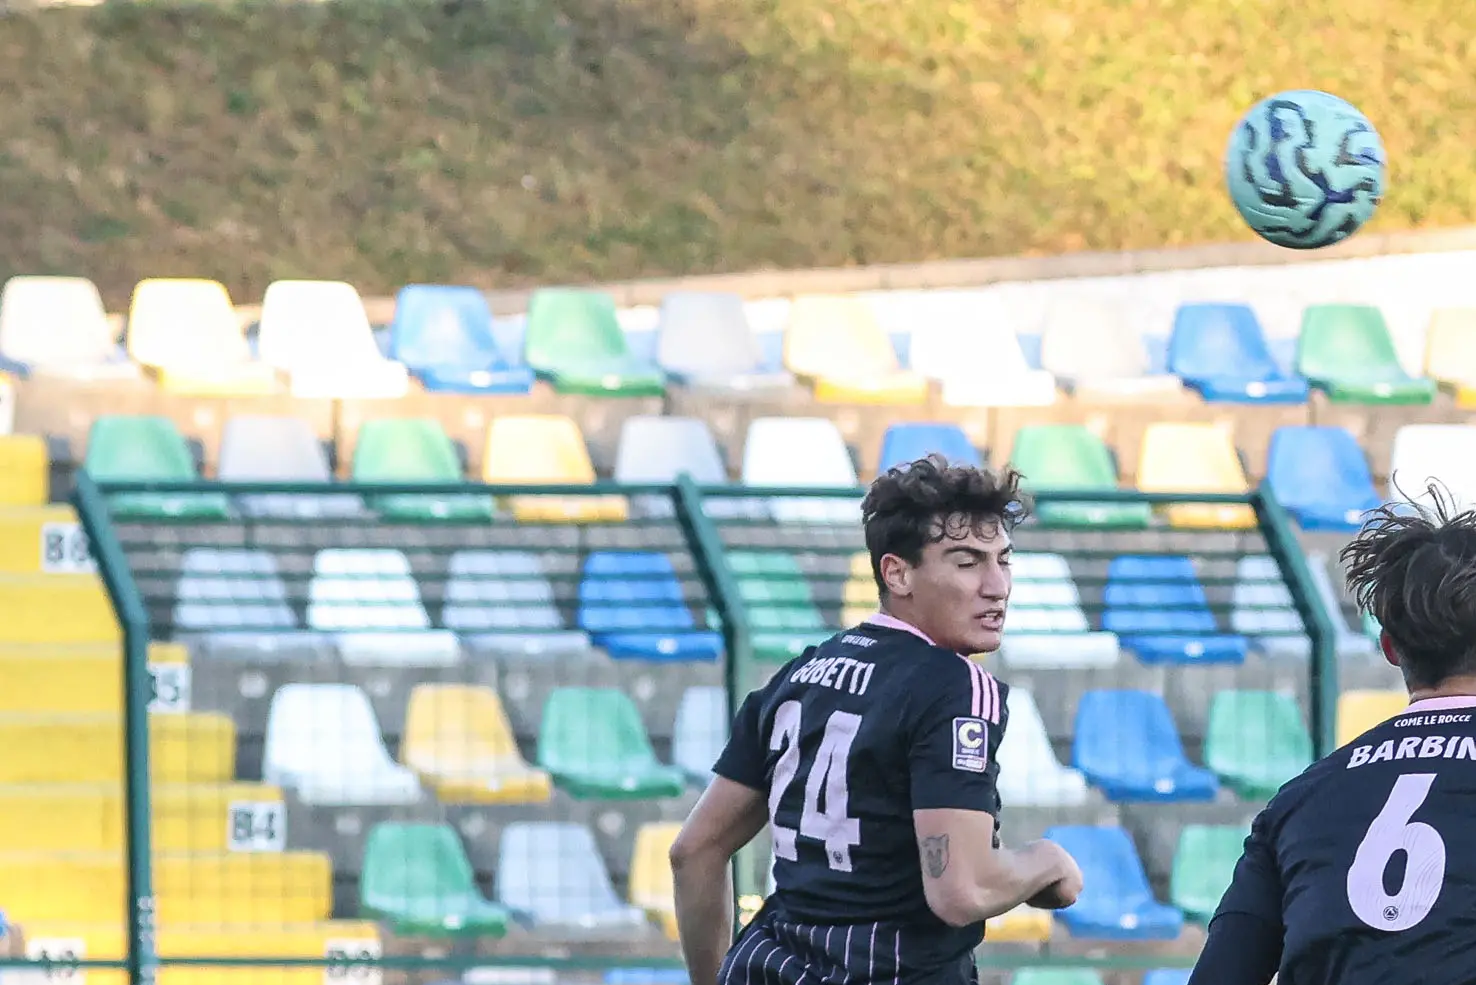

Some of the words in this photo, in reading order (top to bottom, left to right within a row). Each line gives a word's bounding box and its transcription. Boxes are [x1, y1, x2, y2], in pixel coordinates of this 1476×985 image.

[767, 700, 863, 873] 24
[1394, 716, 1423, 728] COME
[1423, 715, 1438, 726] LE
[1437, 714, 1473, 725] ROCCE
[1346, 772, 1447, 932] 6
